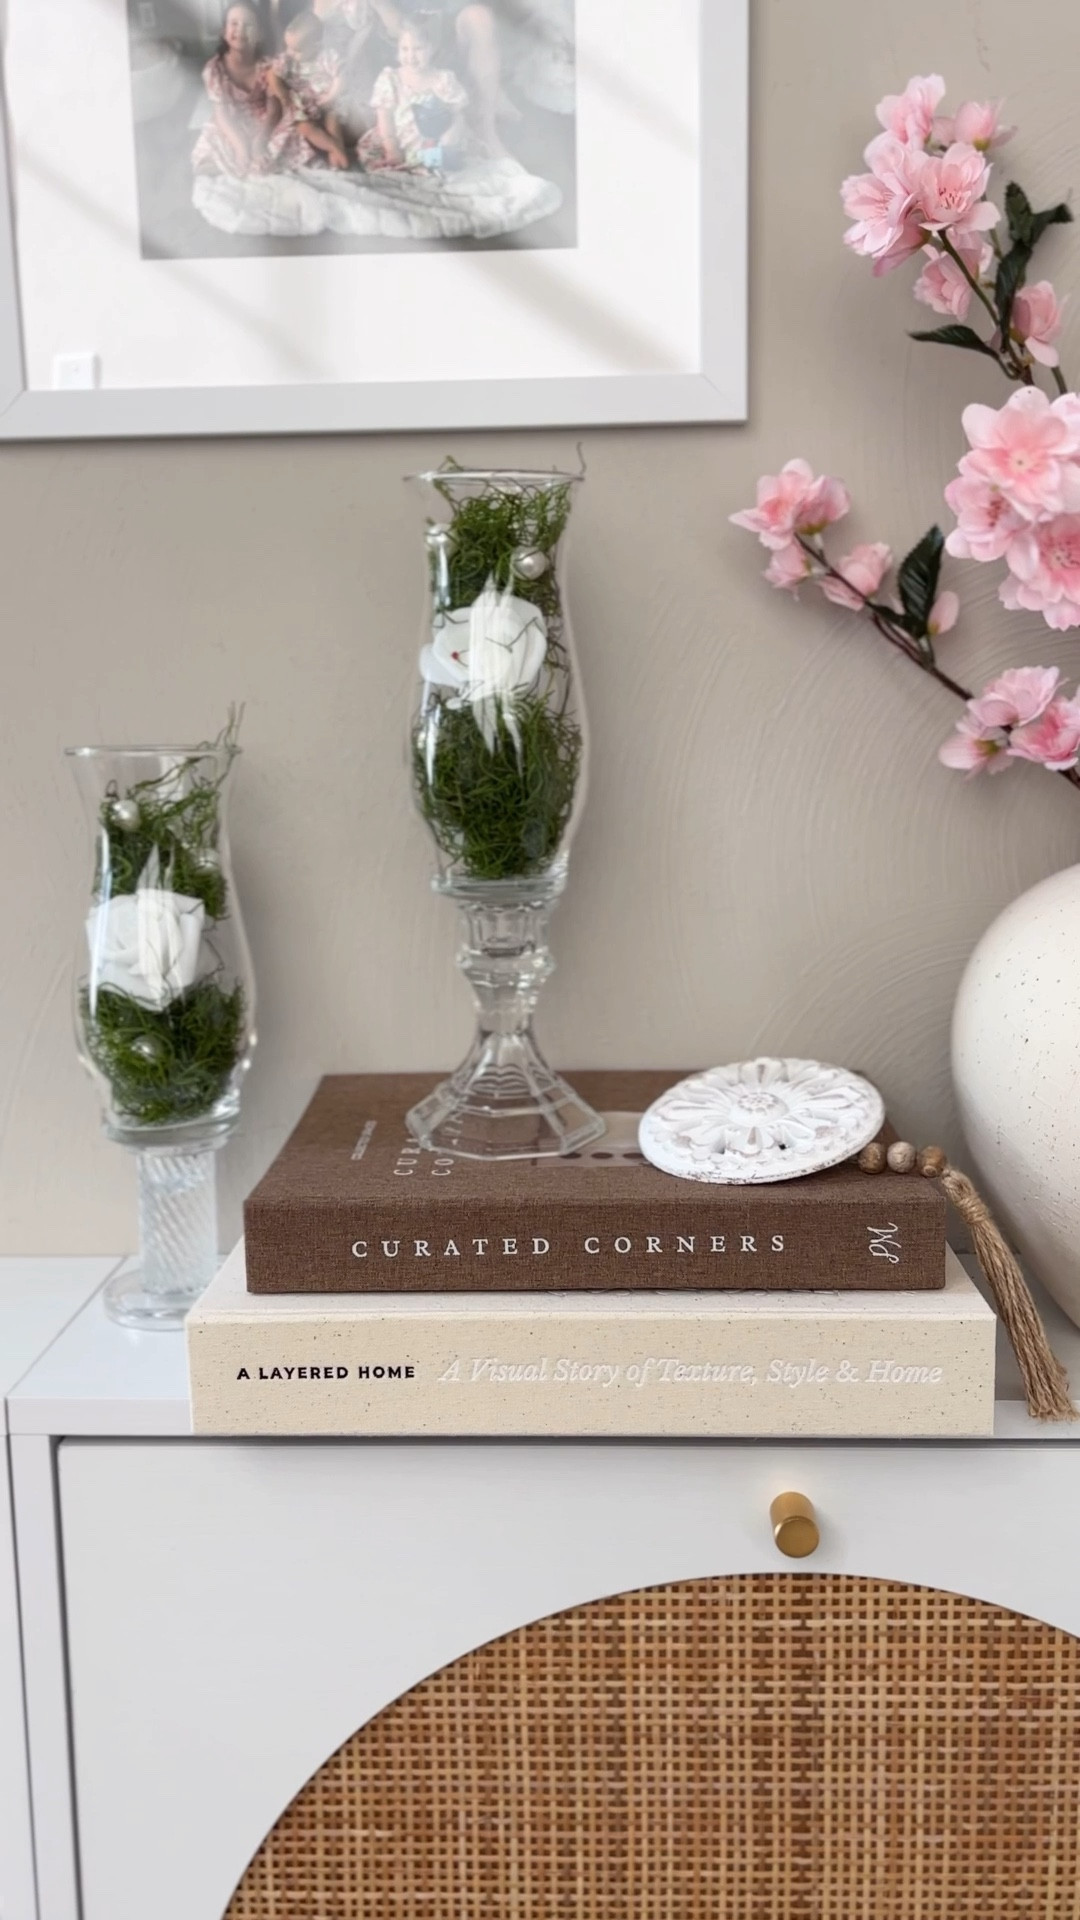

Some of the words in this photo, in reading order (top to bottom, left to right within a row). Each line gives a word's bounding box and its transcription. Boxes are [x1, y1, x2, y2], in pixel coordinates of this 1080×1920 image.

[351, 1237, 550, 1258] CURATED
[584, 1234, 784, 1254] CORNERS
[236, 1367, 250, 1381] A
[258, 1366, 349, 1380] LAYERED
[358, 1365, 416, 1380] HOME
[437, 1358, 462, 1382] A
[470, 1357, 549, 1382] Visual
[553, 1358, 620, 1388] Story
[626, 1357, 656, 1388] of
[656, 1358, 758, 1386] Texture,
[766, 1358, 831, 1389] Style
[835, 1359, 860, 1383] &
[865, 1359, 944, 1383] Home
